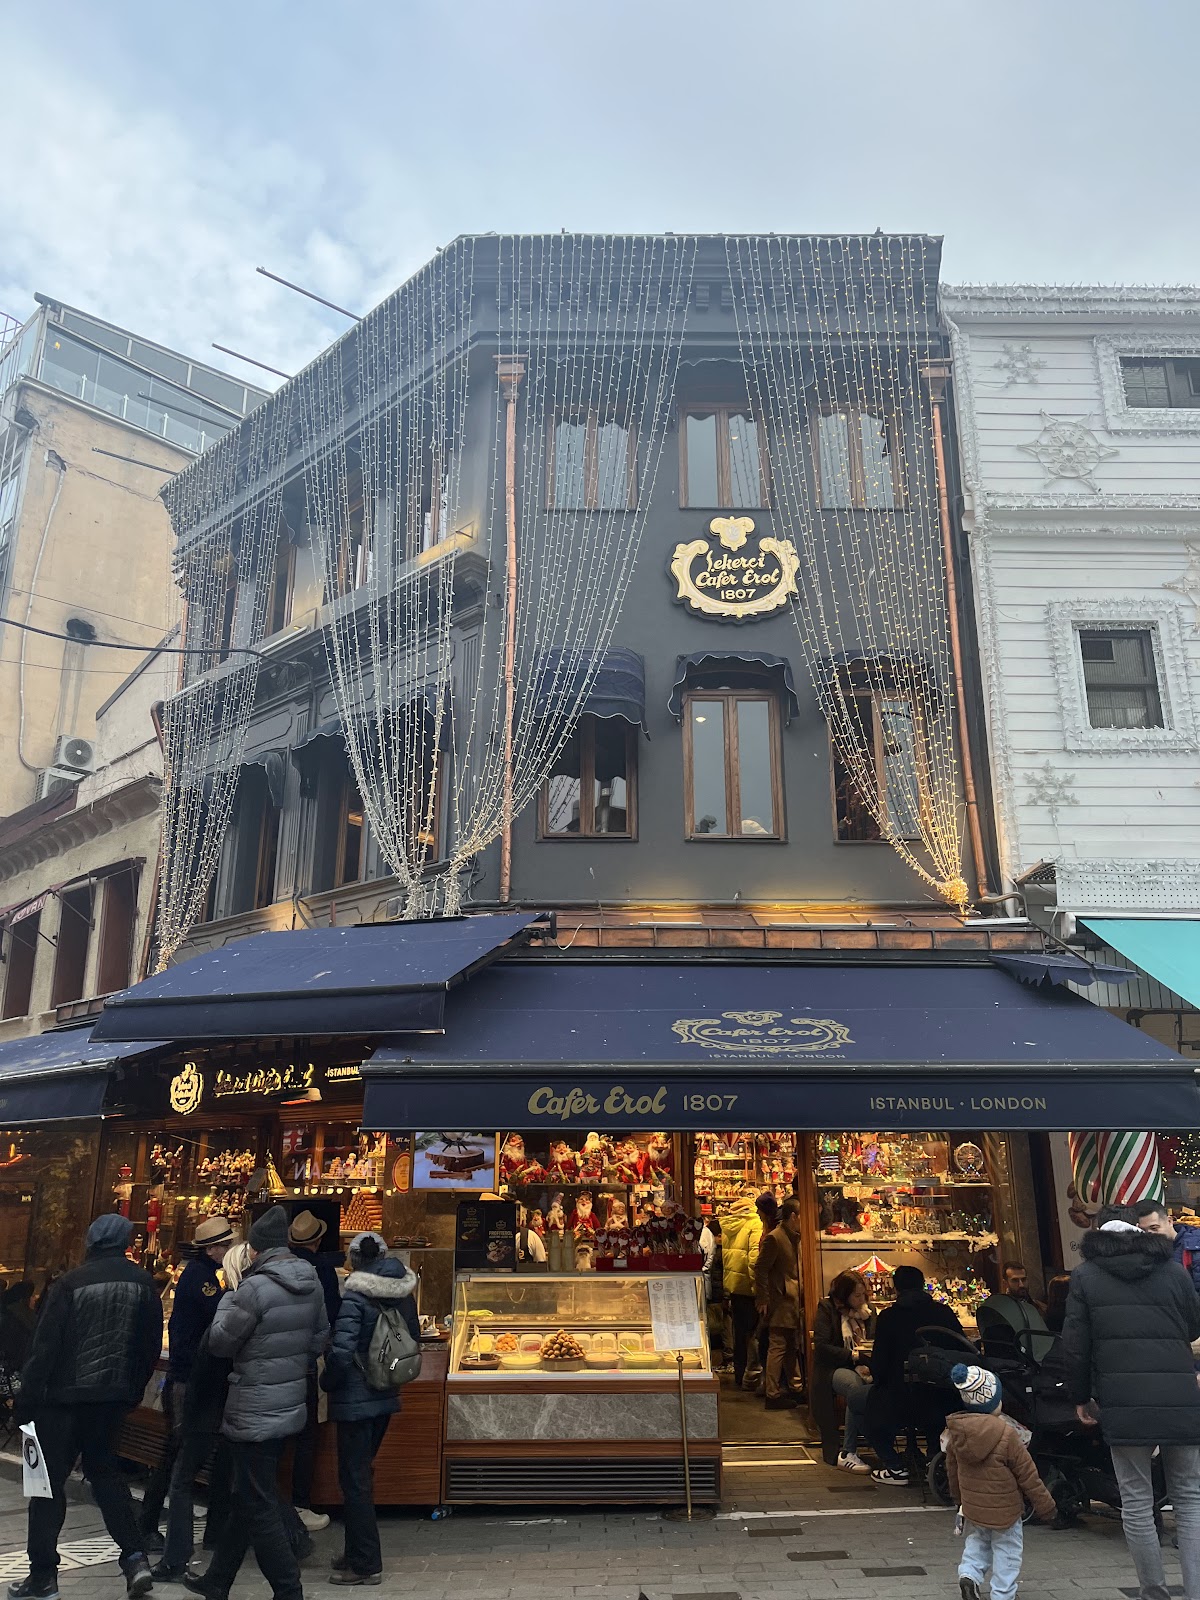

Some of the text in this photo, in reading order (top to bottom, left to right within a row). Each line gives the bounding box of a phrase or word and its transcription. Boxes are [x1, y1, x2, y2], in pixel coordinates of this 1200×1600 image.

[695, 568, 780, 590] Cafer Erol
[720, 588, 756, 600] 1807
[701, 1027, 823, 1037] Cafer Erol
[527, 1085, 738, 1121] Cafer Erol 1807
[870, 1097, 1047, 1110] ISTANBUL LONDON
